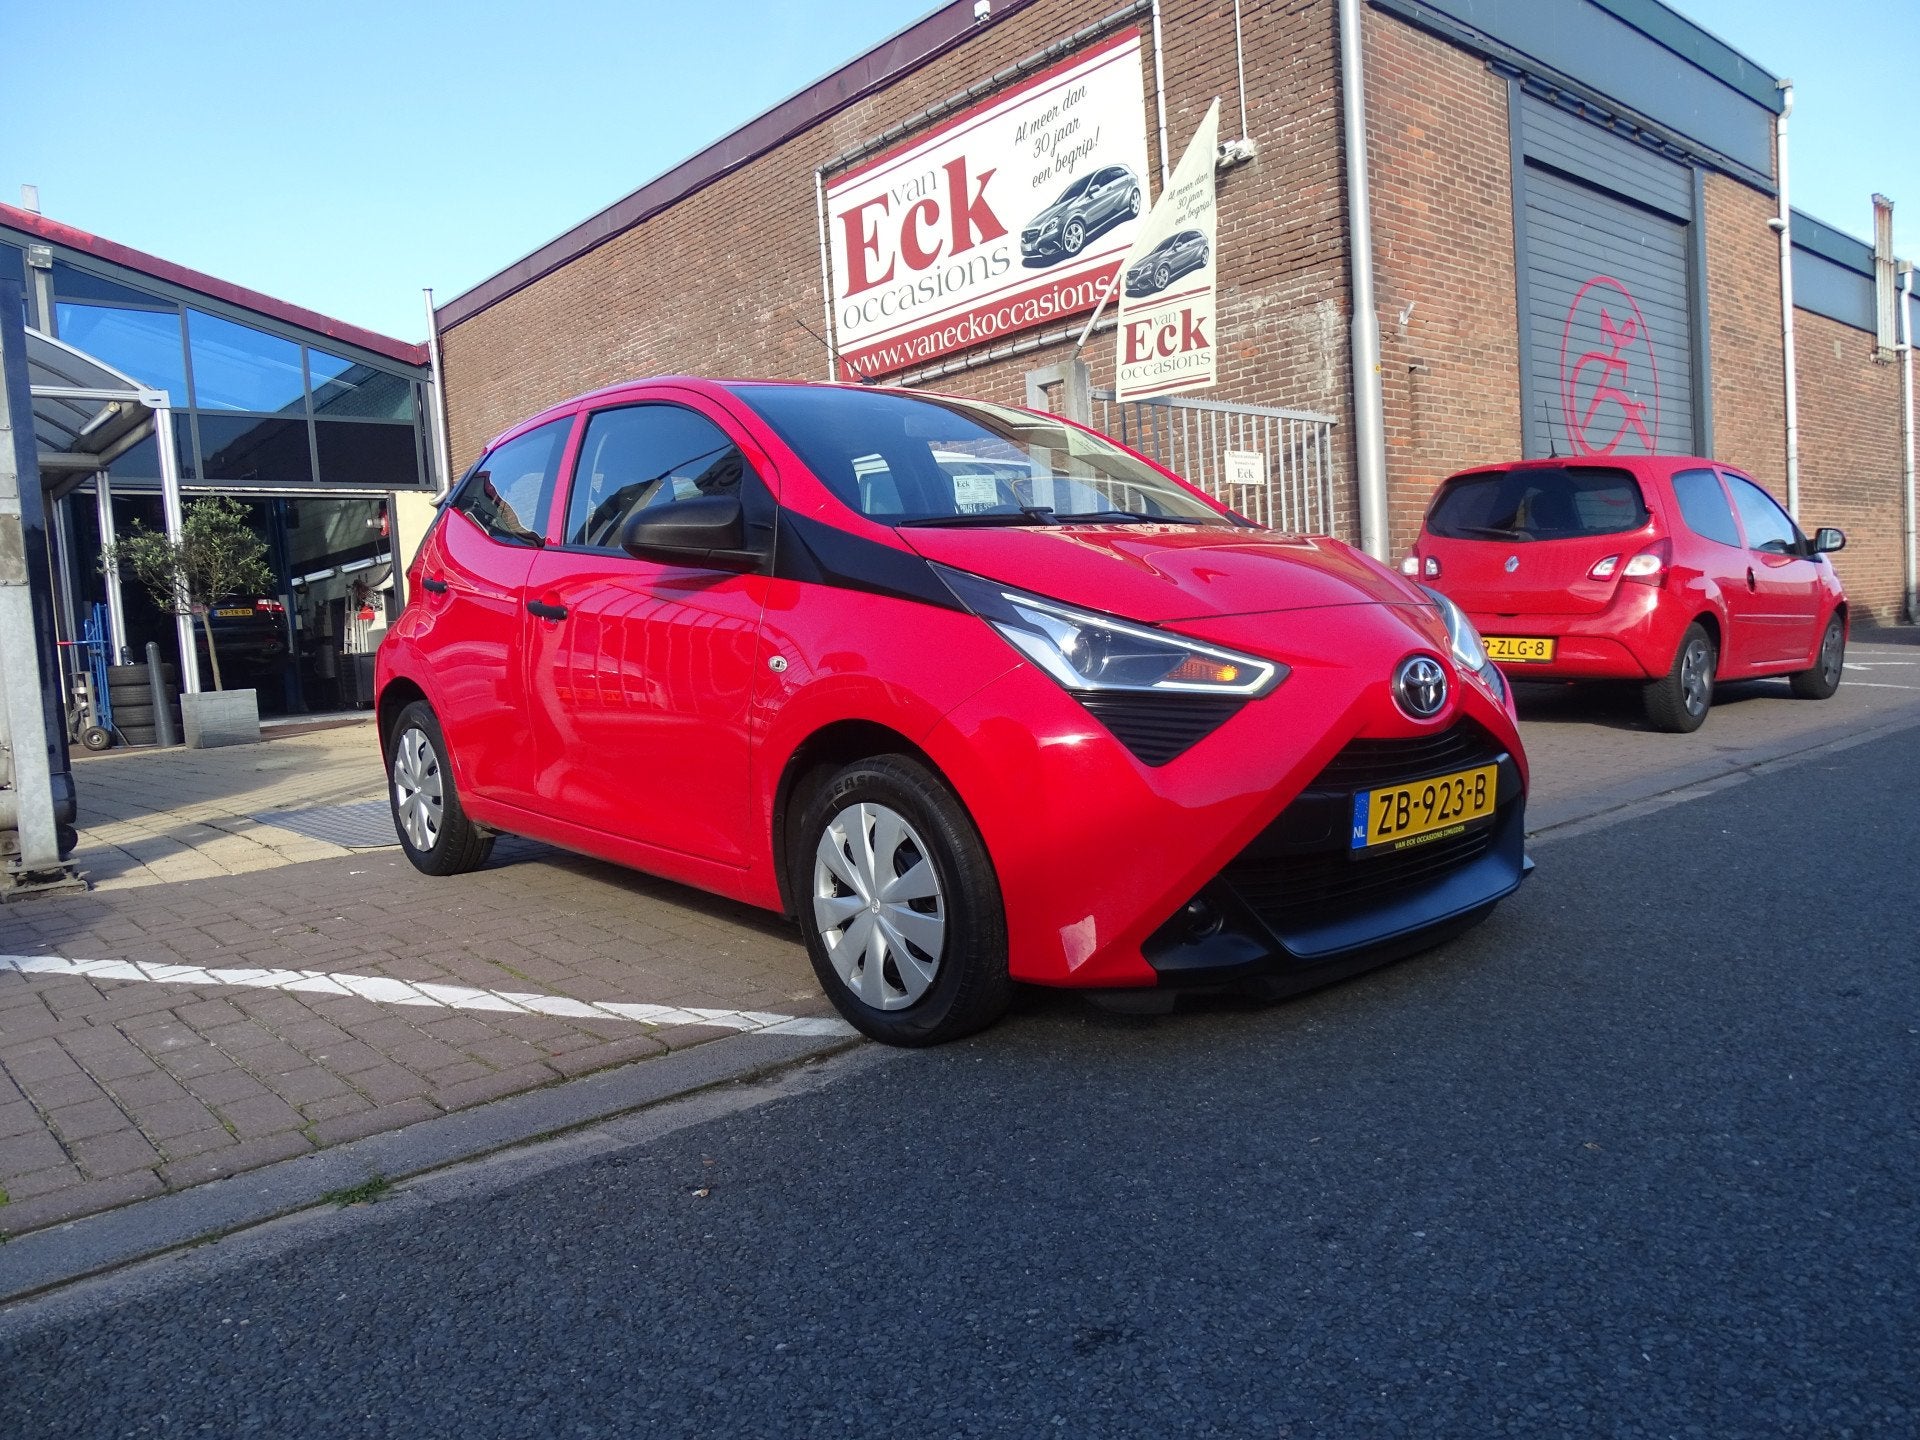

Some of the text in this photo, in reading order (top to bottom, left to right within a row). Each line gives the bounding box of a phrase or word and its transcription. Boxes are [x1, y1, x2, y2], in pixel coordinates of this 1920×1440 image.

[1015, 85, 1087, 146] Al meer dan
[1033, 117, 1081, 158] 30 jaar
[1032, 125, 1100, 188] een begrip!
[891, 171, 937, 206] van
[837, 155, 1008, 299] Eck
[843, 246, 1011, 329] occasions
[845, 275, 1118, 378] www.vaneckoccasions.
[1121, 308, 1211, 366] Eck
[1153, 311, 1177, 326] van
[1121, 351, 1211, 381] occasions
[1483, 639, 1545, 656] 9-ZLG-8
[1353, 826, 1366, 839] NL
[1377, 774, 1486, 836] ZB-923-B
